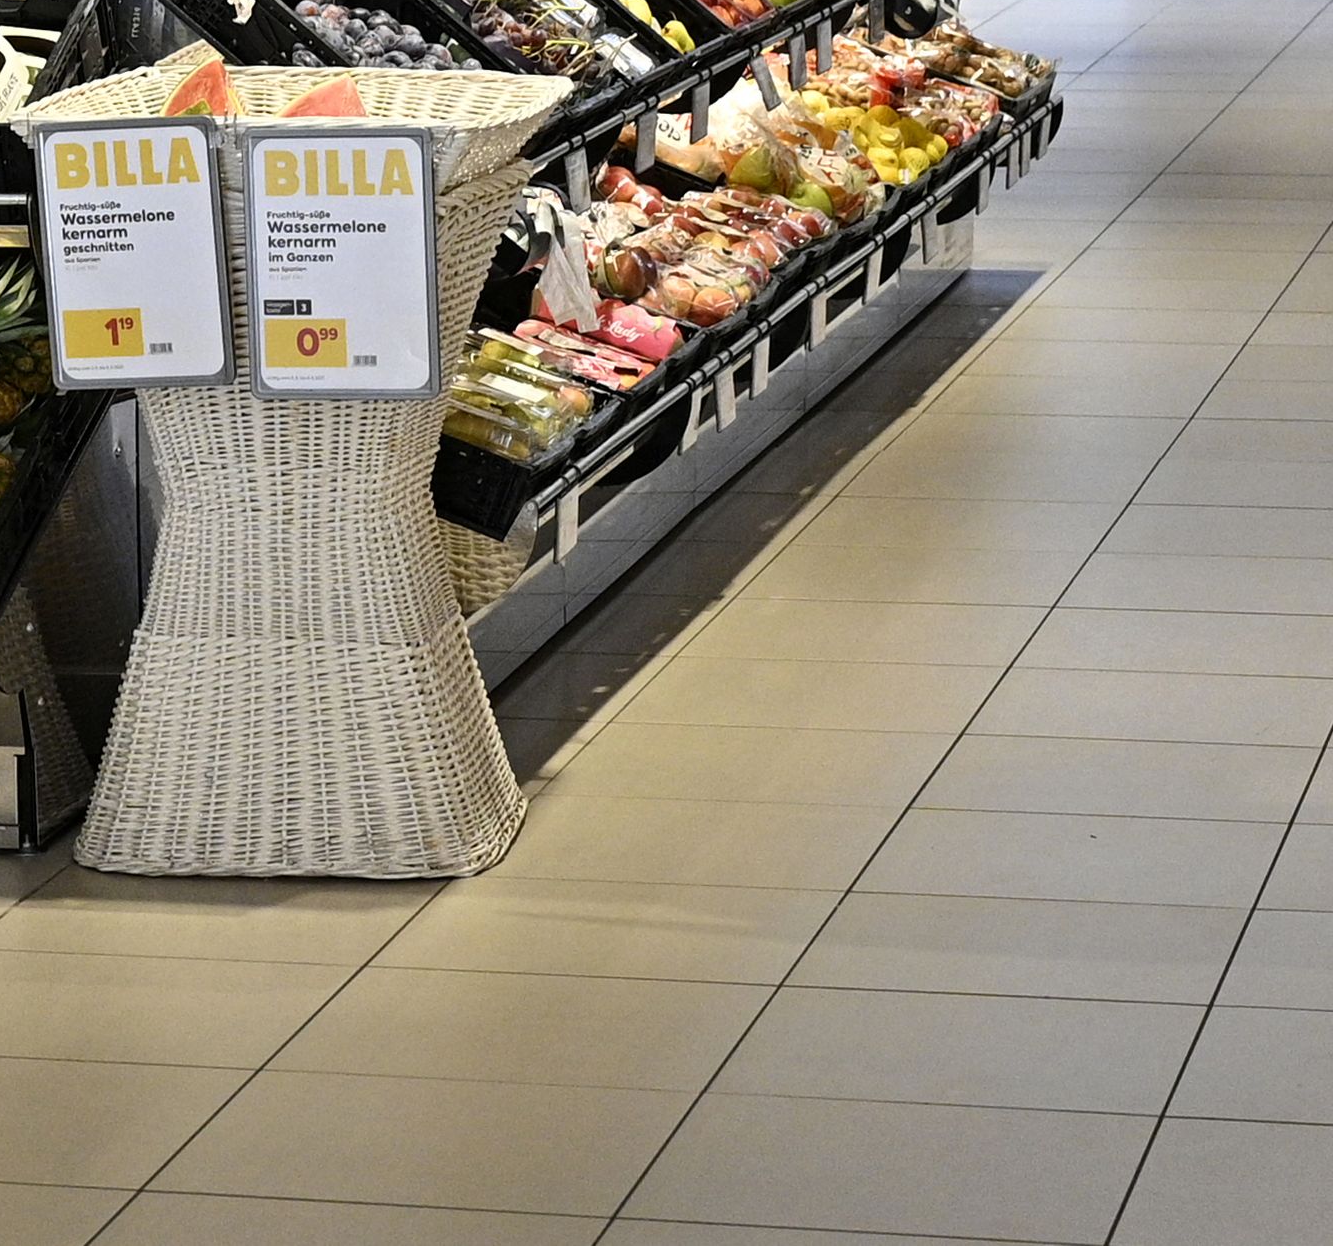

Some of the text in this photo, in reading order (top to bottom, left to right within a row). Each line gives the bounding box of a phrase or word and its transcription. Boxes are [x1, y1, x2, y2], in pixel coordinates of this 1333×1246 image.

[54, 137, 200, 190] BILLA
[263, 148, 414, 197] BILLA
[59, 201, 121, 211] Fruchtig-süße
[61, 209, 175, 225] Wassermelone
[266, 210, 331, 220] Fruchtig-süße
[267, 220, 386, 233] Wassermelone
[62, 227, 128, 240] kernarm
[268, 235, 337, 248] kernarm
[63, 242, 134, 256] geschnitten
[268, 252, 333, 262] im Ganzen
[605, 320, 644, 343] Lady
